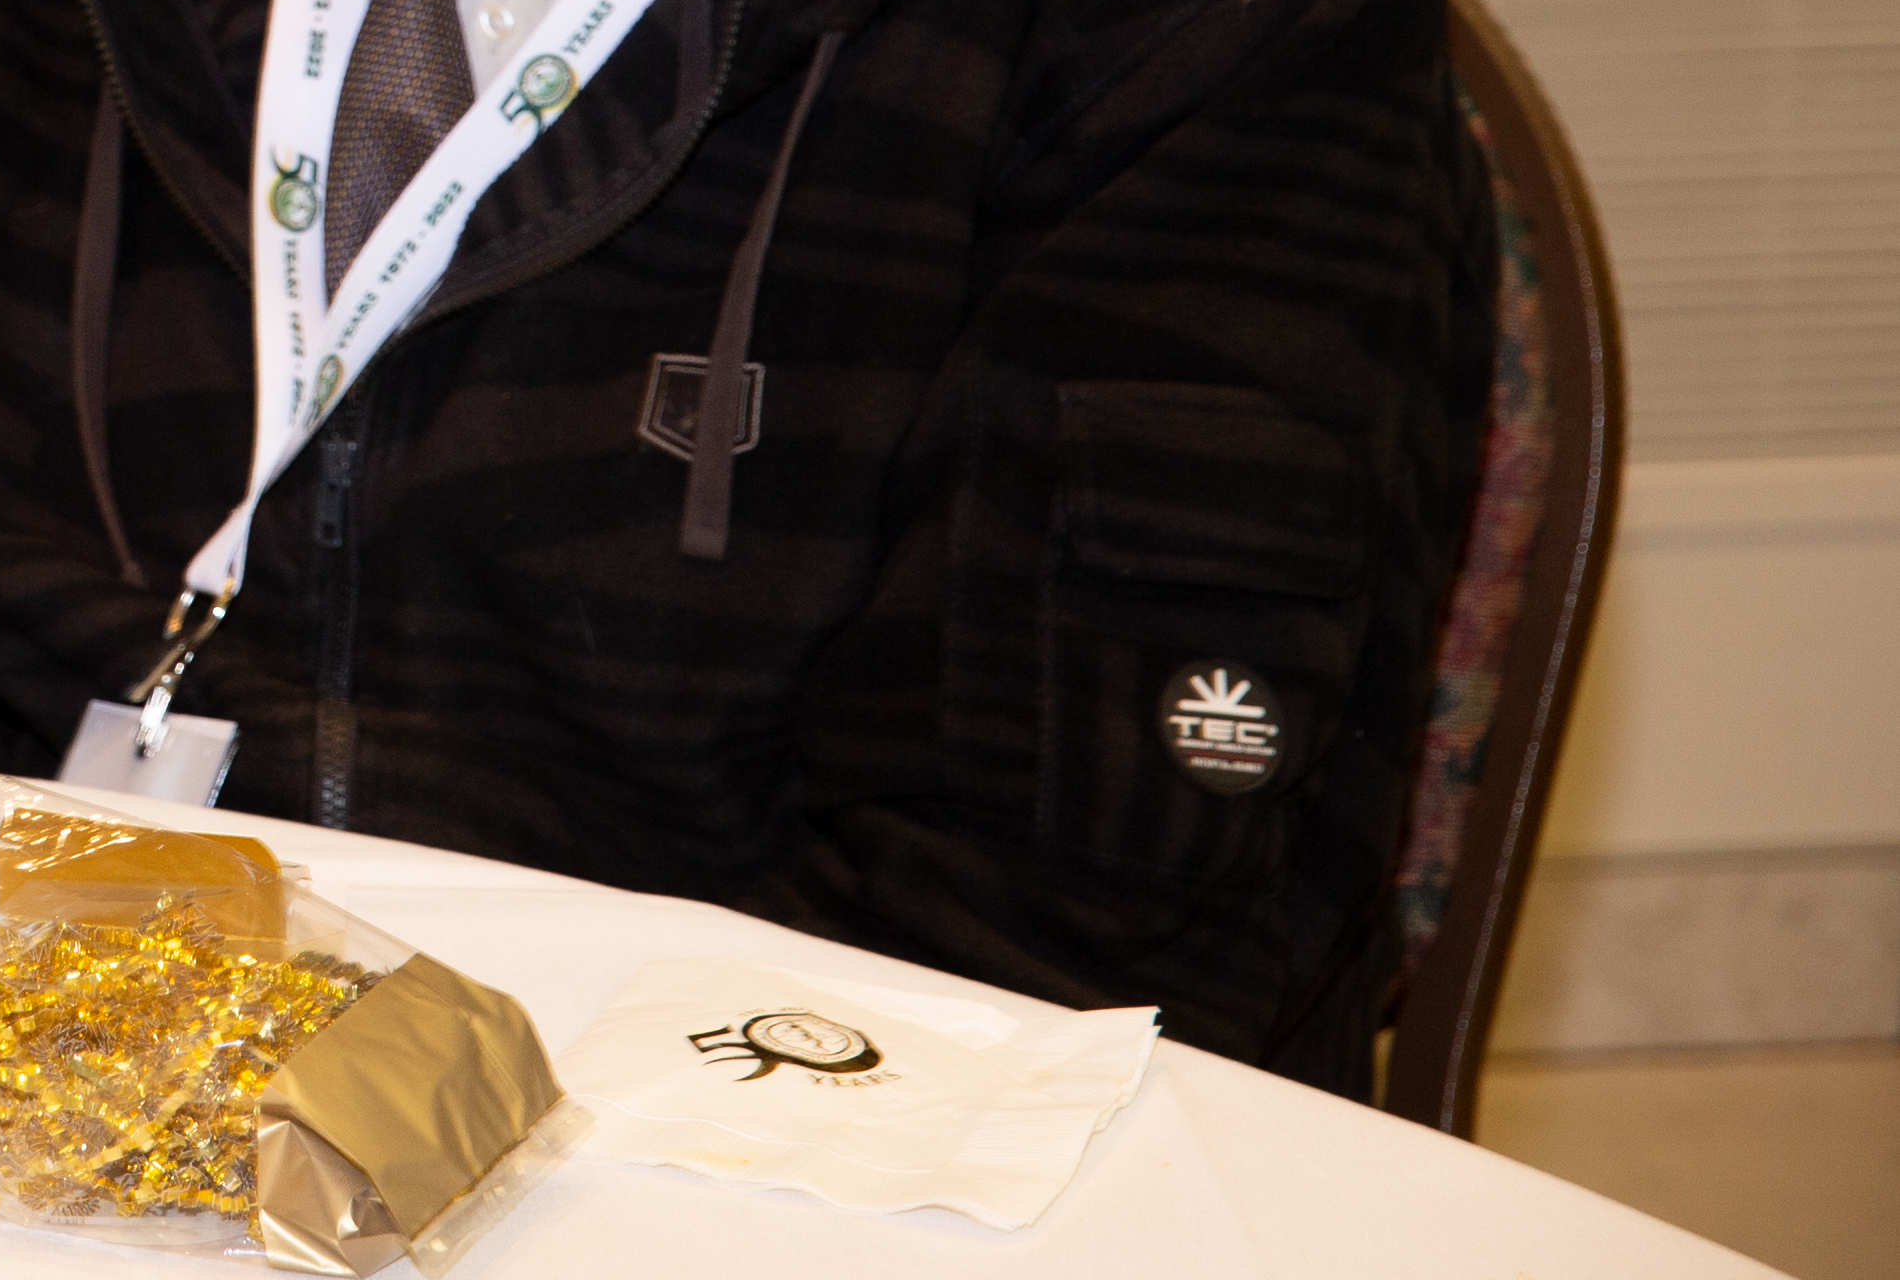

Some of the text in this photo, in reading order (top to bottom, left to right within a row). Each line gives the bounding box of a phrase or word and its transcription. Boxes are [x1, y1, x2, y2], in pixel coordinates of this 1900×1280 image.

[302, 29, 327, 79] 2022
[336, 291, 379, 349] YEARS
[377, 238, 420, 284] 1972
[423, 179, 465, 228] 2022
[807, 1067, 902, 1088] YEARS
